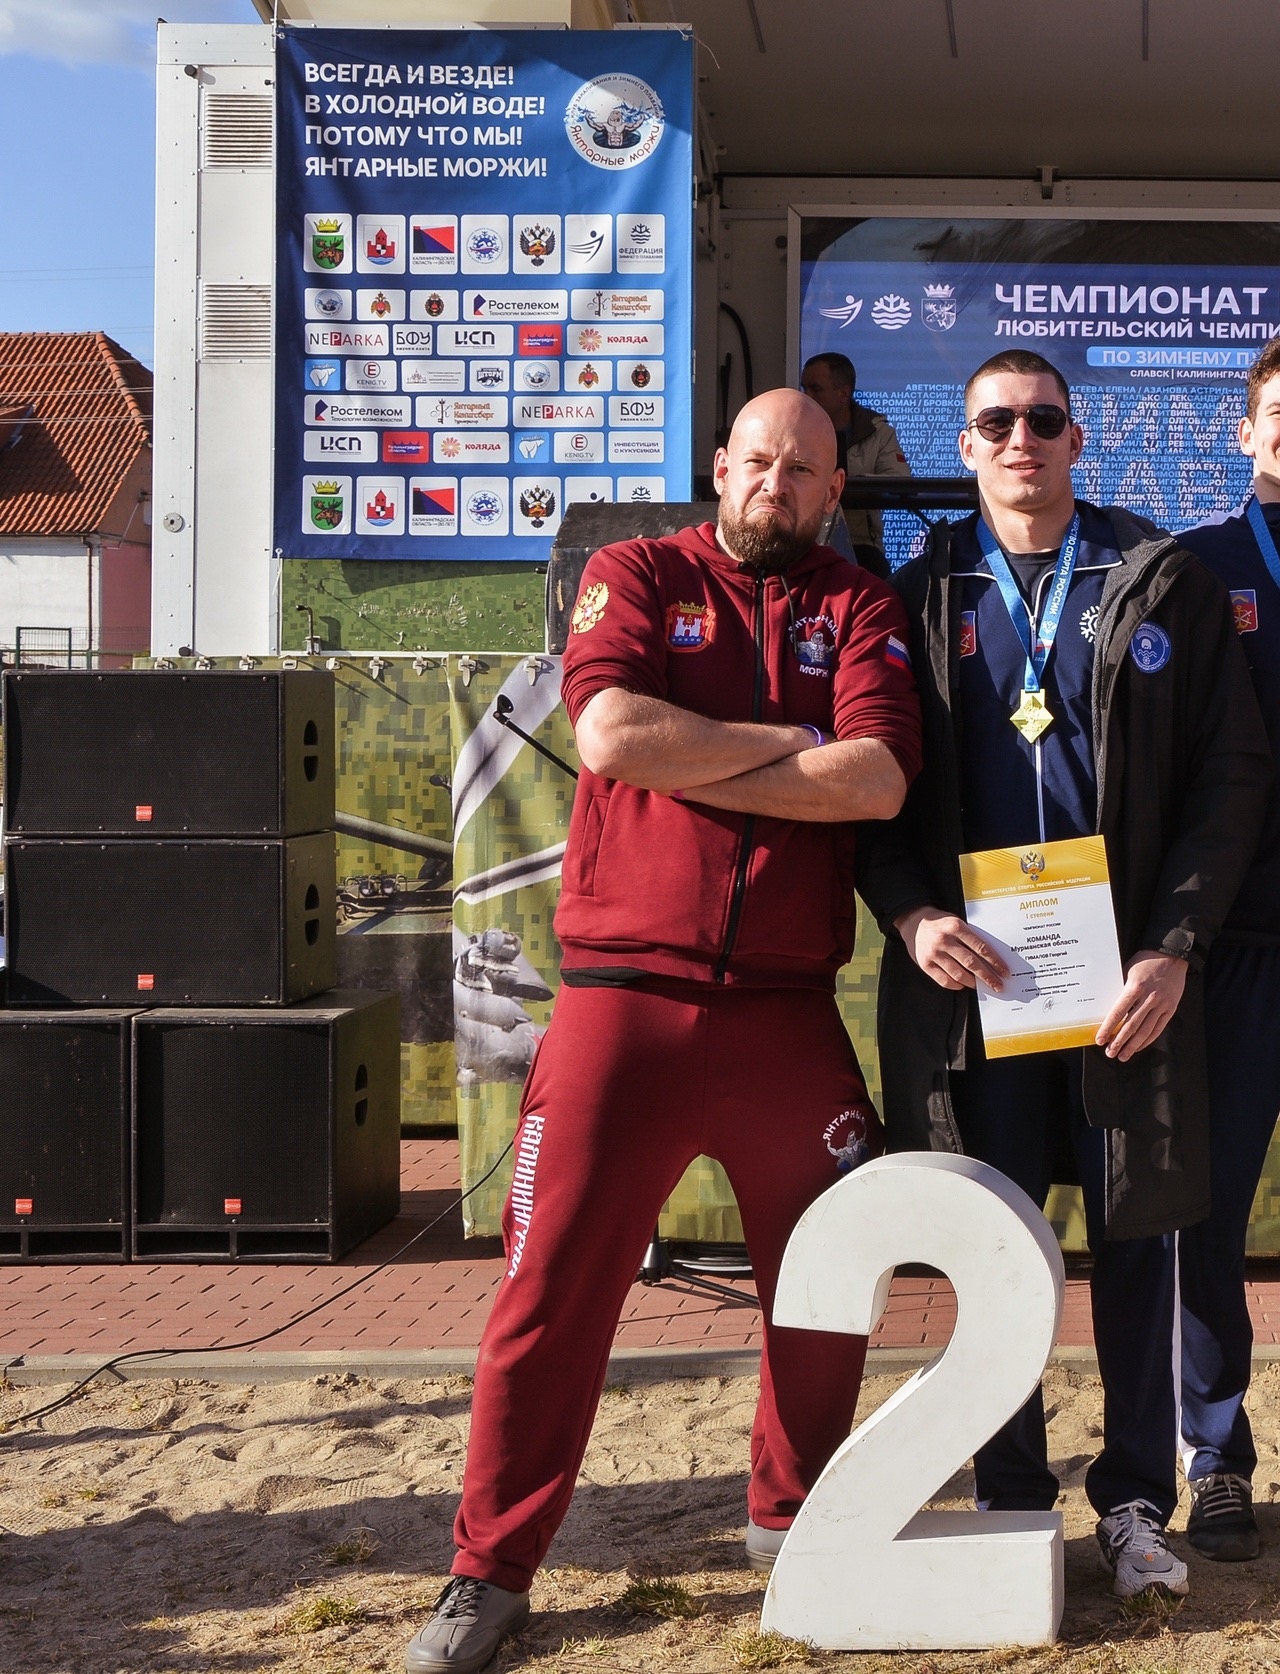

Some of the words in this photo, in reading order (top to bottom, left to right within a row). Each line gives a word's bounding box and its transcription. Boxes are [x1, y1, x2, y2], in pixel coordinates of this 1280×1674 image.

[305, 63, 401, 87] ВСЕГДА
[407, 65, 424, 84] И
[430, 65, 514, 89] ВЕЗДЕ!
[305, 95, 320, 113] В
[326, 92, 467, 118] ХОЛОДНОЙ
[473, 96, 545, 118] ВОДЕ!
[305, 125, 411, 146] ПОТОМУ
[418, 126, 468, 146] ЧТО
[474, 126, 522, 146] МЫ!
[305, 157, 437, 177] ЯНТАРНЫЕ
[444, 157, 547, 177] МОРЖИ!
[618, 247, 663, 255] ФЕДЕРАЦИЯ
[488, 300, 559, 310] Ростелеком
[995, 283, 1268, 315] ЧЕМПИОНАТ
[994, 318, 1193, 338] ЛЮБИТЕЛЬСКИЙ
[309, 332, 384, 346] NEPARKA
[396, 331, 431, 345] БФУ
[1103, 350, 1131, 364] ПО
[1137, 350, 1229, 365] ЗИМНЕМУ
[1130, 370, 1169, 378] СЛАВСК
[1176, 370, 1250, 379] КАЛИНИНГРАД
[330, 405, 403, 416] Ростелеком
[522, 404, 595, 419] NEPARKA
[620, 402, 654, 416] БФУ
[927, 414, 951, 422] ОЛЕГ
[896, 422, 929, 430] ДИАНА
[1060, 546, 1075, 576] СПОРТА
[1049, 578, 1066, 616] РОССИИ
[1019, 897, 1058, 911] ДИПЛОМ
[1010, 943, 1051, 953] Мурманская
[1052, 938, 1079, 947] область
[1026, 933, 1061, 943] КОМАНДА
[822, 1109, 865, 1141] ЯНТАРНЫ
[761, 1151, 1065, 1650] 2
